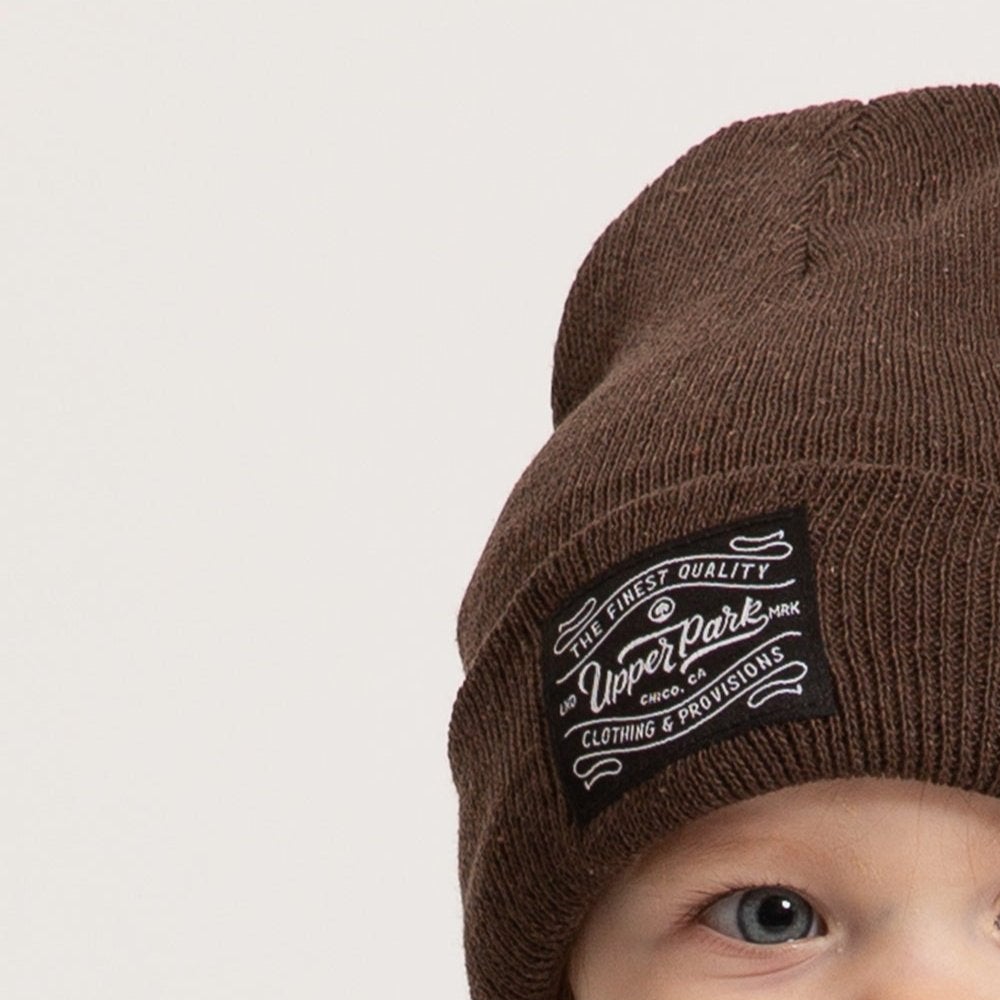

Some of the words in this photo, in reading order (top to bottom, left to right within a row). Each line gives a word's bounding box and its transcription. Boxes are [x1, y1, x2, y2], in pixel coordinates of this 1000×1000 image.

[569, 620, 604, 659] THE
[606, 567, 669, 621] FINEST
[678, 561, 771, 581] QUALITY
[578, 637, 677, 714] Upper
[676, 596, 770, 674] Park
[768, 600, 801, 620] MRK
[581, 719, 656, 749] CLOTHING
[661, 715, 674, 733] &
[677, 645, 786, 725] PROVISIONS
[687, 667, 708, 686] CA
